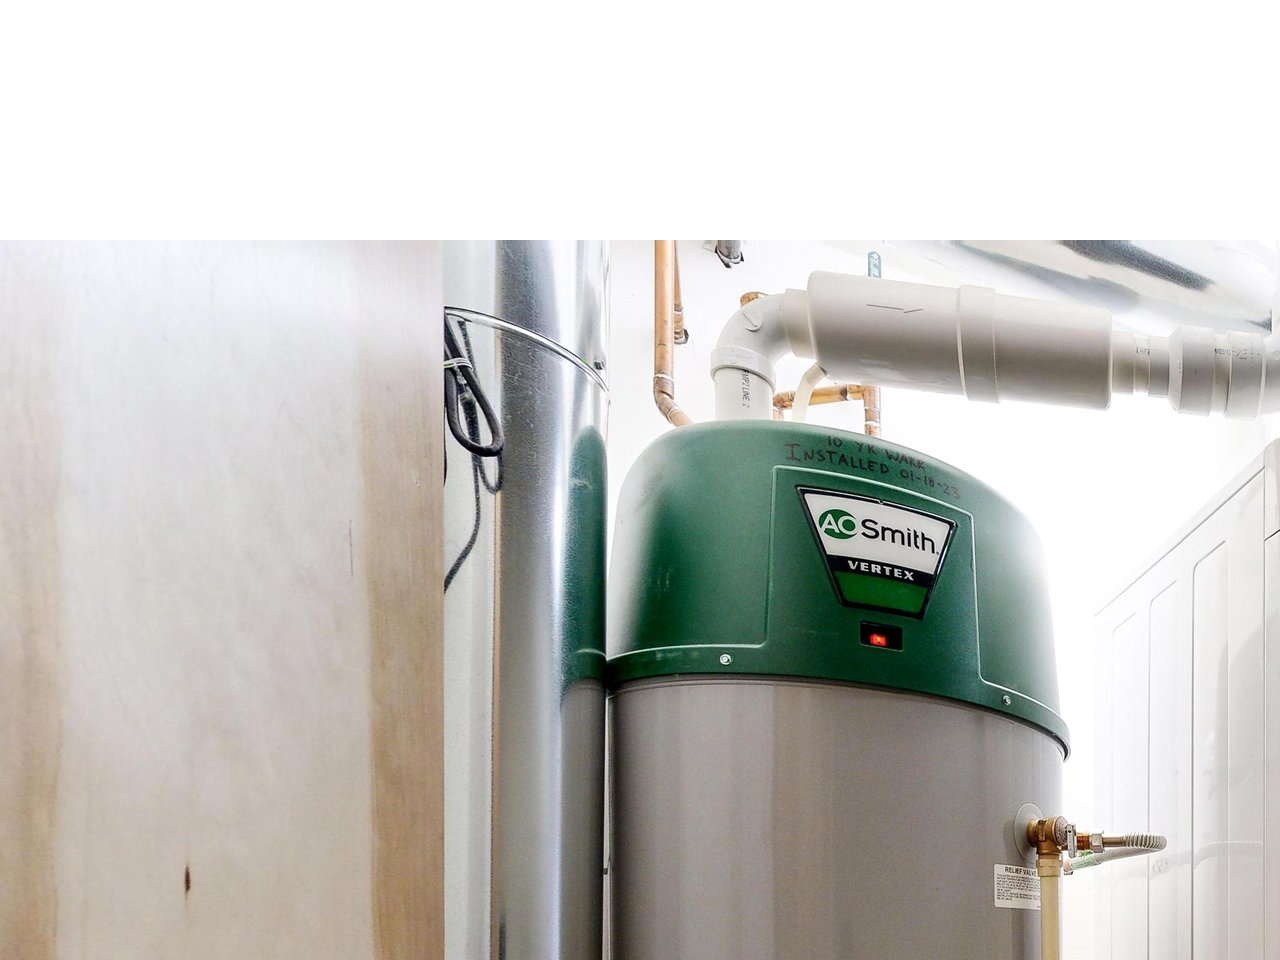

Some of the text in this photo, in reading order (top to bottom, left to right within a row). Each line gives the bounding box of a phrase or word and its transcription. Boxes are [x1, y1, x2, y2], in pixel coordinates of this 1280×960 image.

[828, 436, 843, 448] 10
[856, 442, 878, 454] YR
[784, 443, 961, 499] INSTALLED 01-18-23
[848, 559, 915, 581] VERTEX
